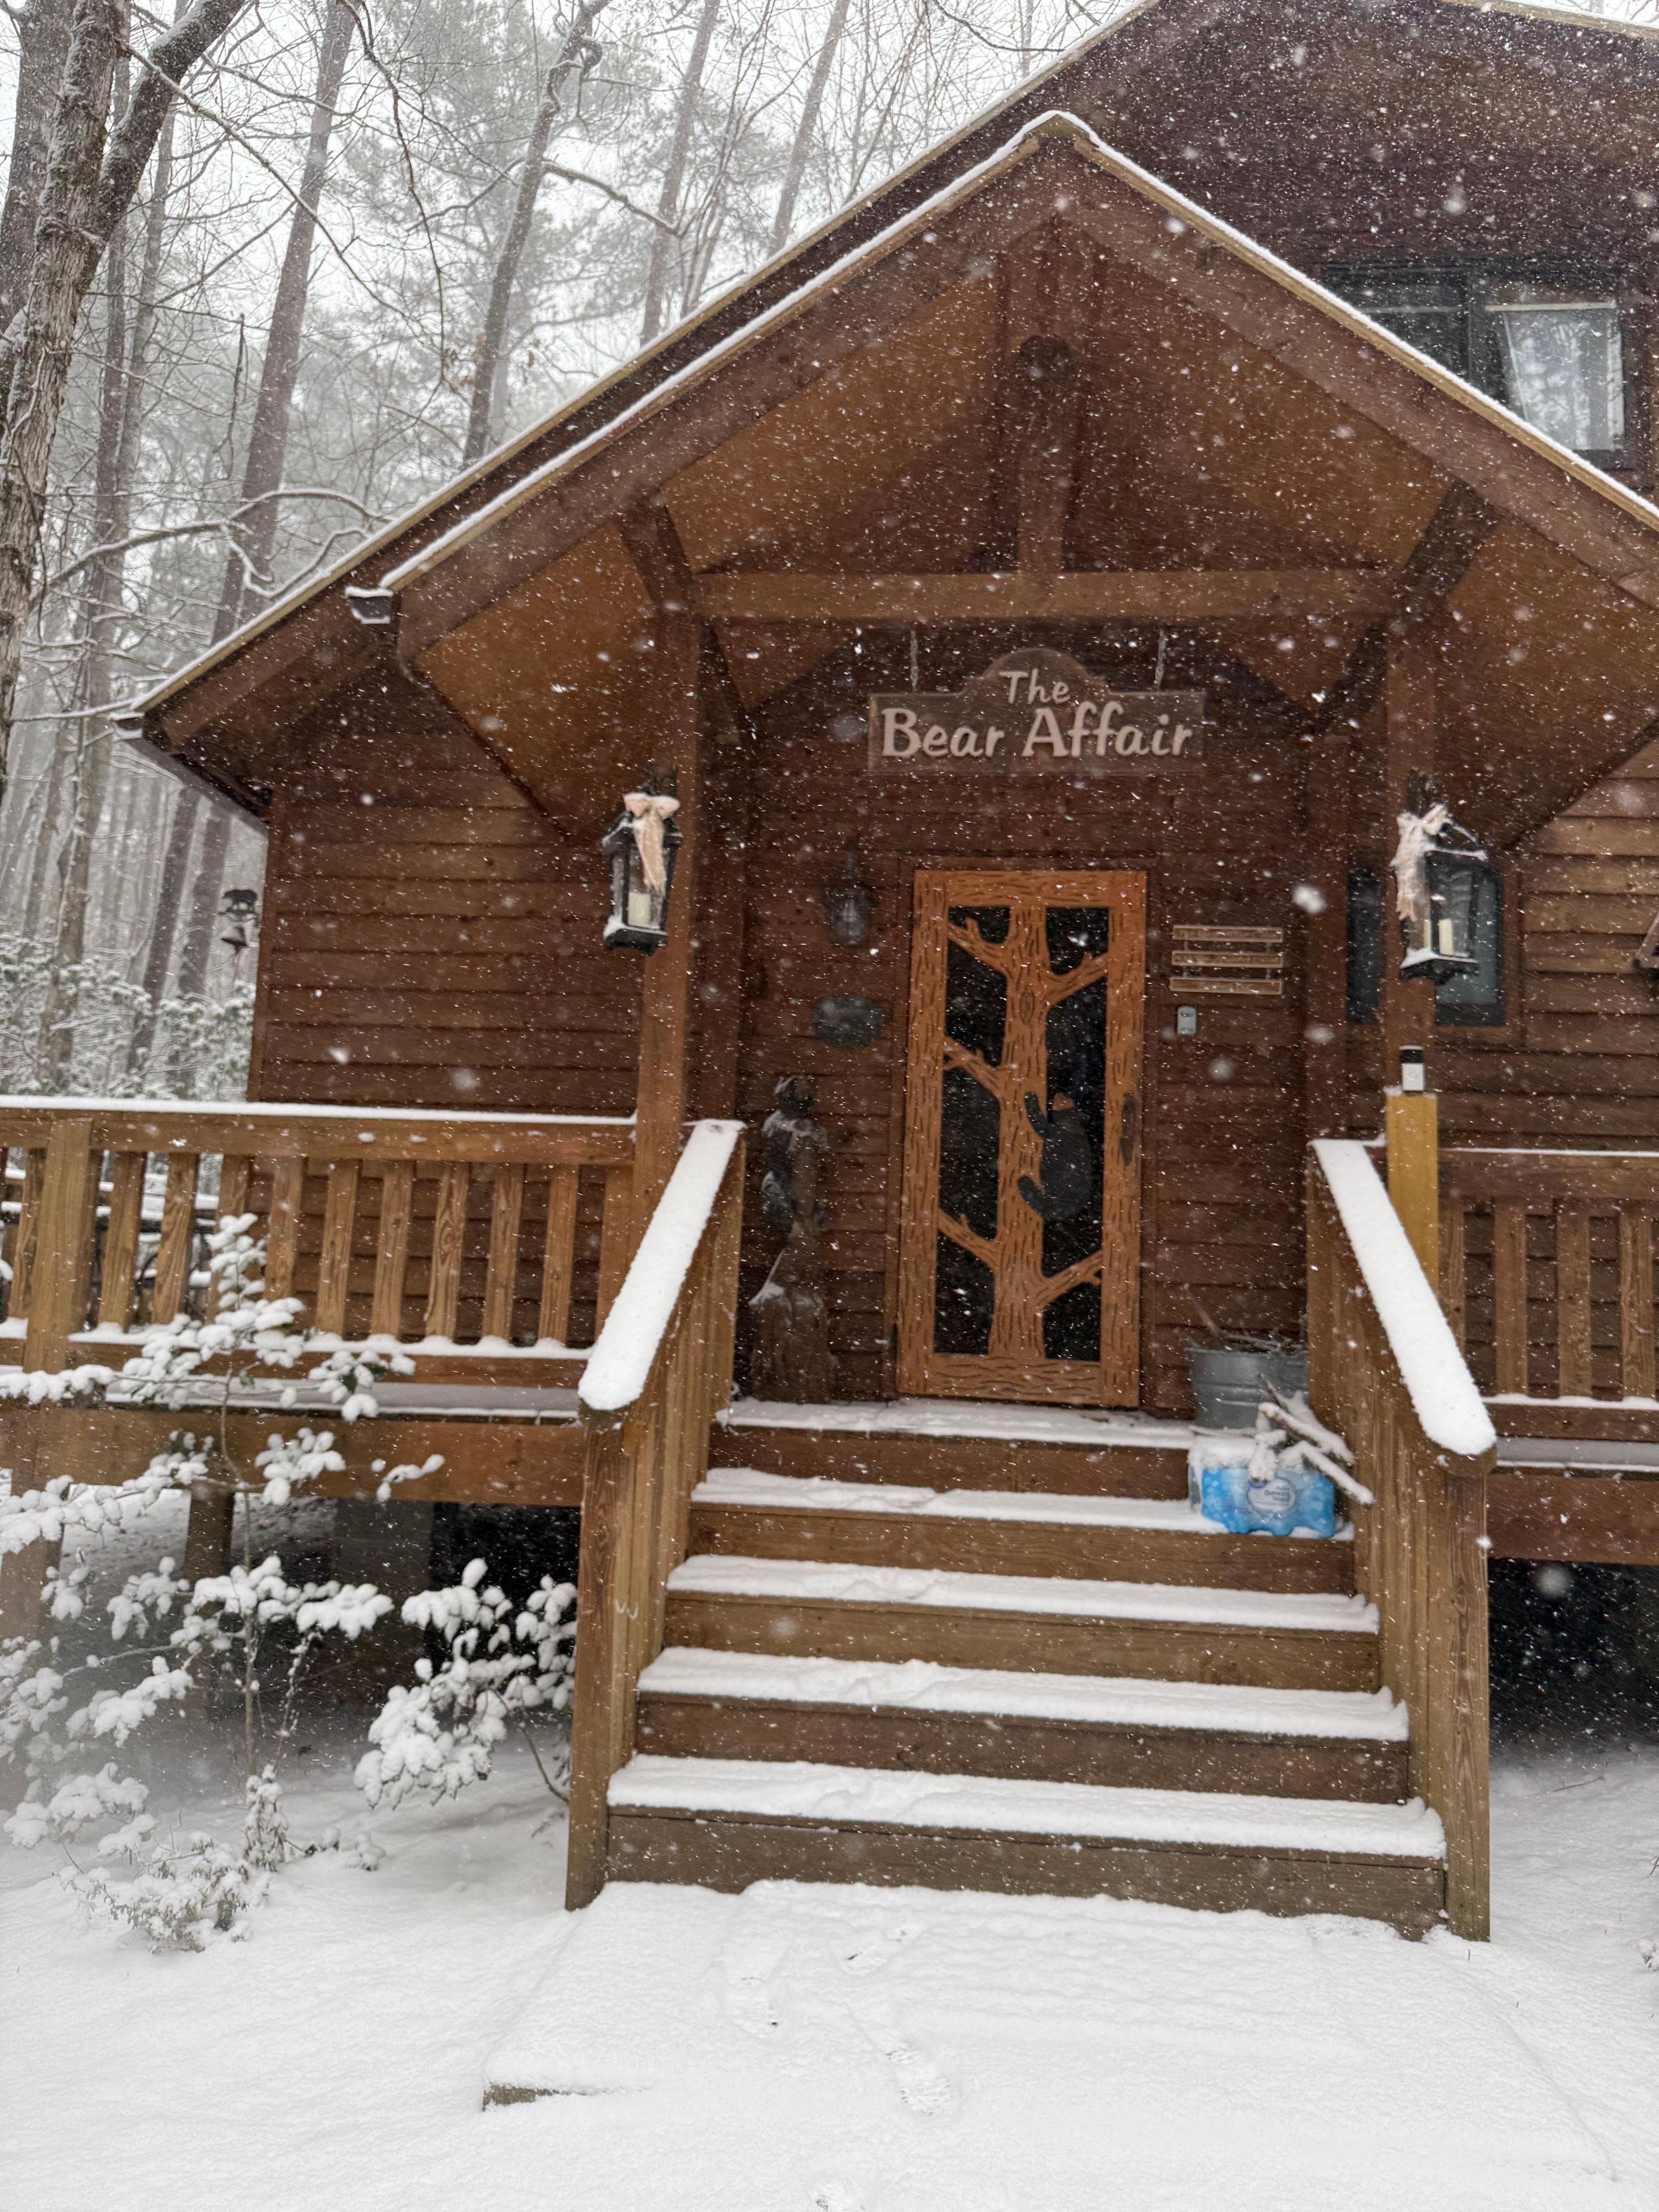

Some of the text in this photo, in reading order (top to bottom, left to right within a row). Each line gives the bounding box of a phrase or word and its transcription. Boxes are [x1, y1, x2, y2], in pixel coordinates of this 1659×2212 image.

[999, 668, 1070, 704] The
[881, 701, 1192, 757] Bear Affair
